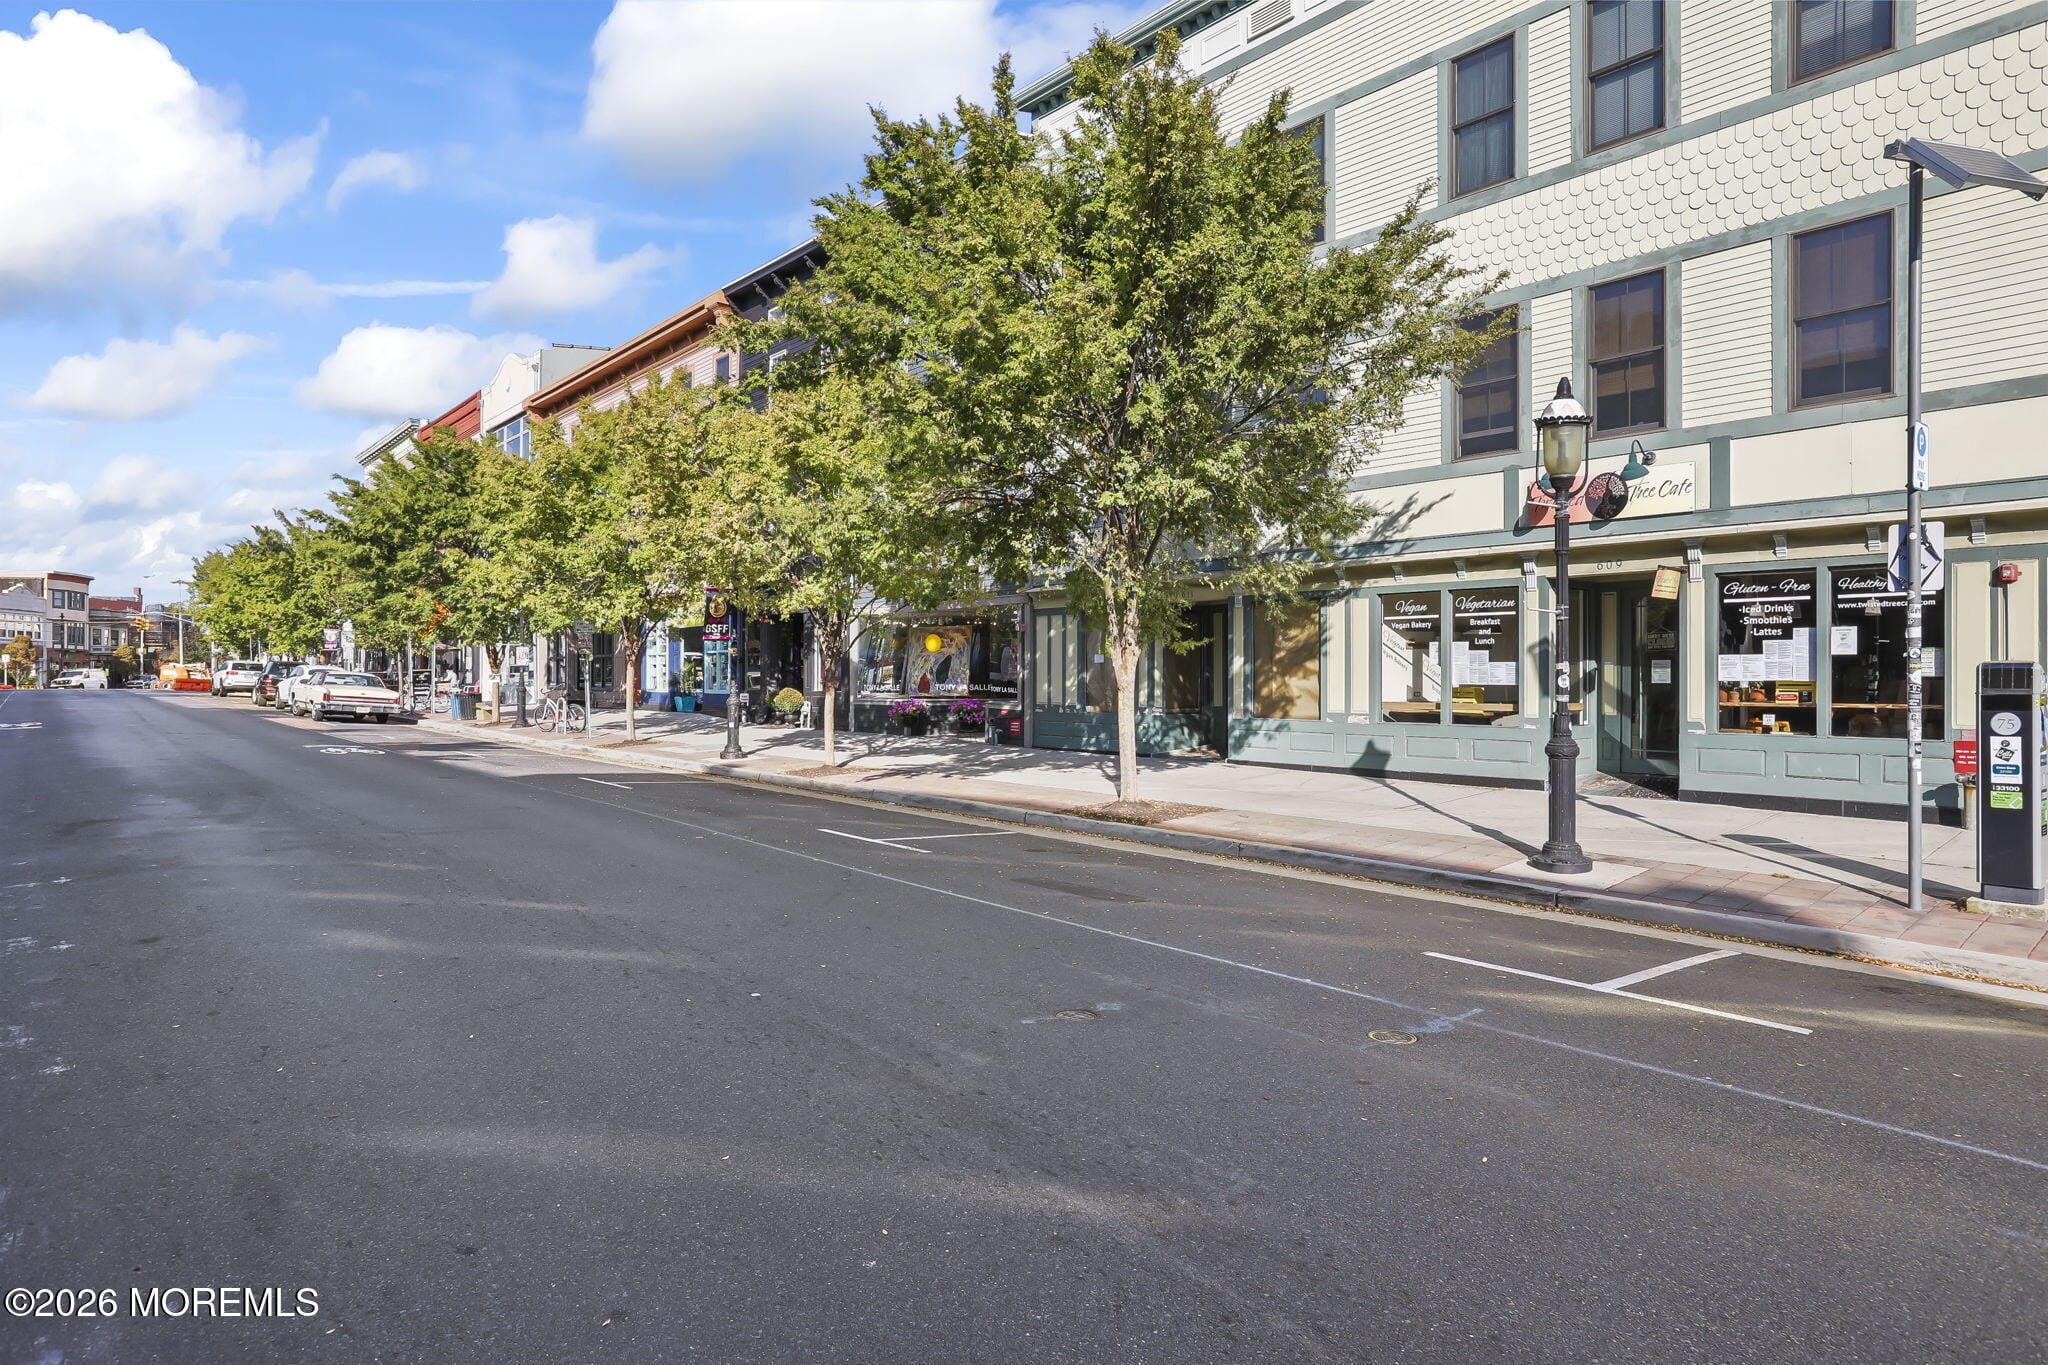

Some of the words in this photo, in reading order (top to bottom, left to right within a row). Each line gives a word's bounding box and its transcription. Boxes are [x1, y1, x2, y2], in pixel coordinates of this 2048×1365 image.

[1628, 480, 1656, 503] Tree
[1658, 478, 1693, 498] Cafe
[1596, 559, 1623, 570] 609
[1723, 581, 1769, 596] Gluten
[1779, 578, 1811, 593] Free
[1837, 576, 1887, 590] Healthy
[1395, 599, 1428, 615] Vegan
[1455, 595, 1517, 612] Vegetarian
[1764, 603, 1794, 613] Drinks
[1837, 599, 1936, 609] www.twistedtreecacom
[1391, 622, 1410, 630] Vegan
[1411, 621, 1432, 630] Bakery
[1469, 617, 1501, 626] Breakfast
[705, 624, 729, 634] GSFF
[1474, 637, 1495, 645] Lunch
[935, 683, 956, 691] TONY
[1997, 718, 2015, 729] 75
